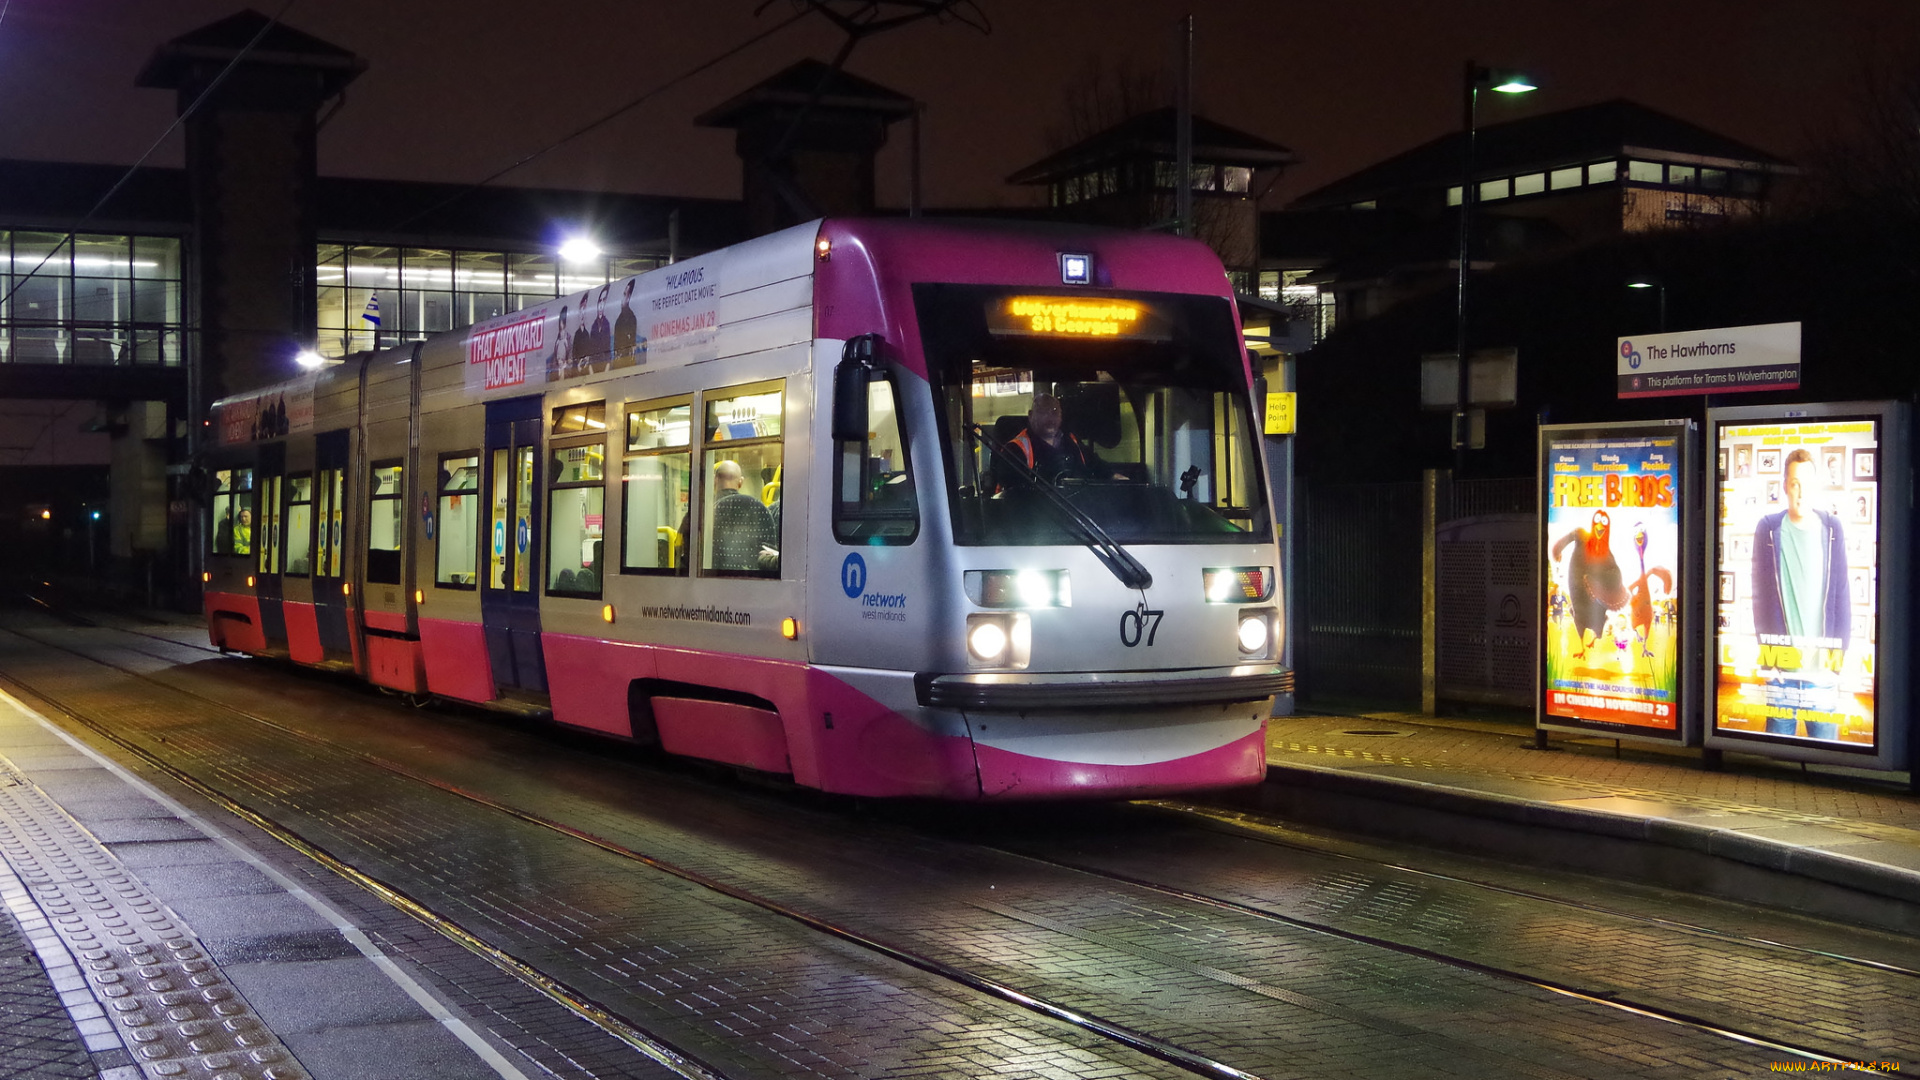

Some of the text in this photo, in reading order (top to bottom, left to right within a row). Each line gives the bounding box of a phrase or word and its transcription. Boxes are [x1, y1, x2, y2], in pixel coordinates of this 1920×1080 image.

[652, 299, 661, 311] THE
[662, 292, 684, 308] PERFECT
[685, 289, 697, 303] DATE
[1013, 301, 1137, 321] Wolverhampton
[651, 324, 659, 340] IN
[660, 316, 690, 337] CINEMAS
[691, 313, 705, 331] JAN
[1032, 316, 1118, 335] St Georges
[473, 331, 495, 363] THAT
[494, 319, 544, 358] AWKWARD
[1647, 341, 1736, 360] The Hawthorns
[486, 354, 525, 388] MOMENT
[1647, 369, 1798, 388] This platform for Trams to Wolverhampton
[1269, 402, 1287, 412] Help
[1268, 413, 1287, 421] Point
[1554, 462, 1580, 472] Wilson
[1592, 462, 1629, 471] Harrelson
[1601, 454, 1620, 463] Woody
[1553, 473, 1674, 508] FREE BIRDS
[862, 592, 907, 608] network
[642, 603, 751, 626] www.networkwestmidlands.com
[862, 609, 907, 622] west midlands
[1120, 610, 1164, 647] 07
[1760, 633, 1792, 645] VINCE
[1584, 681, 1595, 690] THE
[1554, 693, 1669, 716] IN CINEMAS NOVEMBER 29
[1746, 704, 1793, 719] CINEMAS
